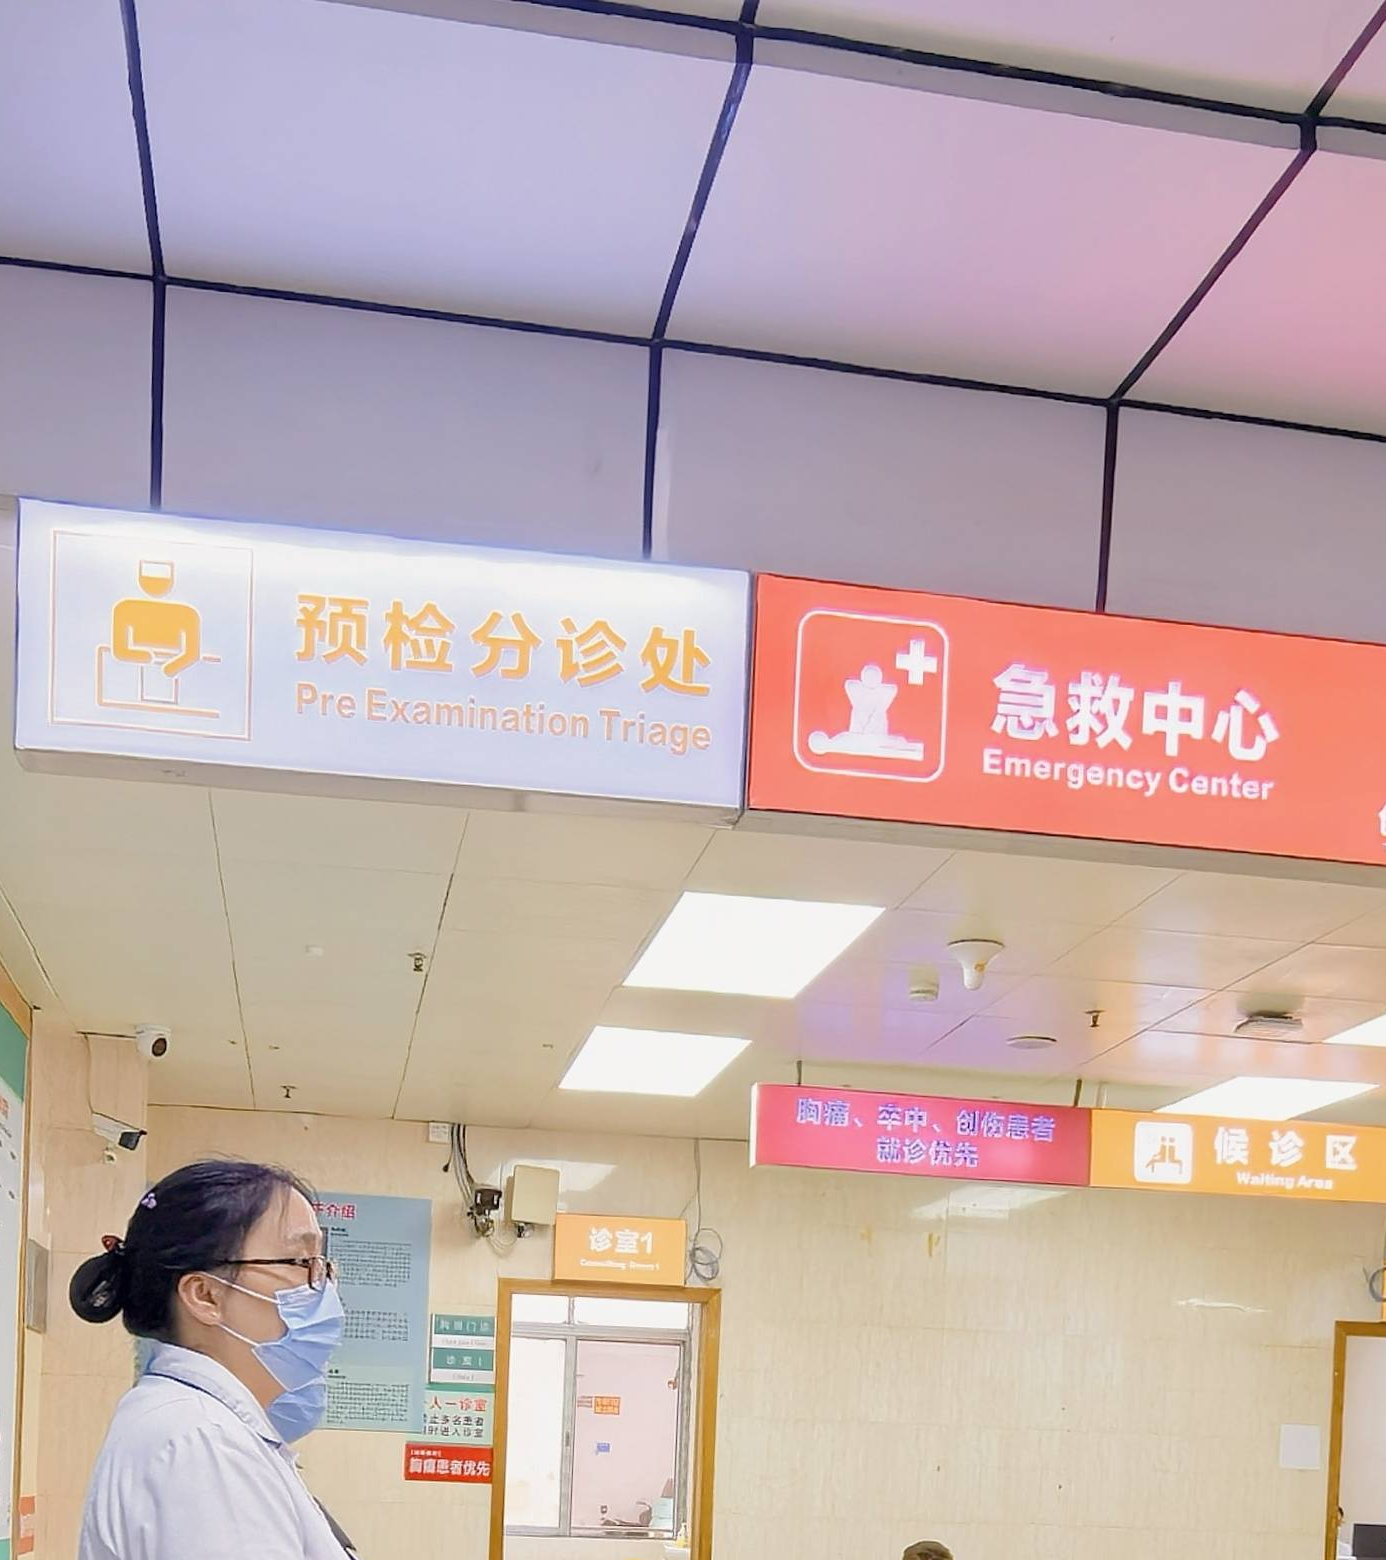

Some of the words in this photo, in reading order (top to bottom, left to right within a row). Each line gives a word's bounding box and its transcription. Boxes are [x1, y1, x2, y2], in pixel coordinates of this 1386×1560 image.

[295, 592, 711, 698] 预检分诊处
[295, 682, 356, 720] Pre
[366, 687, 589, 739] Examination
[600, 708, 712, 756] Triage
[991, 663, 1280, 763] 急救中心
[982, 752, 1162, 799] Emergency
[1168, 761, 1275, 802] Center
[876, 1136, 979, 1168] 就诊优先
[1213, 1125, 1359, 1171] 候诊区
[1236, 1171, 1295, 1191] Waiting
[1297, 1174, 1335, 1191] Area
[588, 1227, 654, 1256] 诊室1
